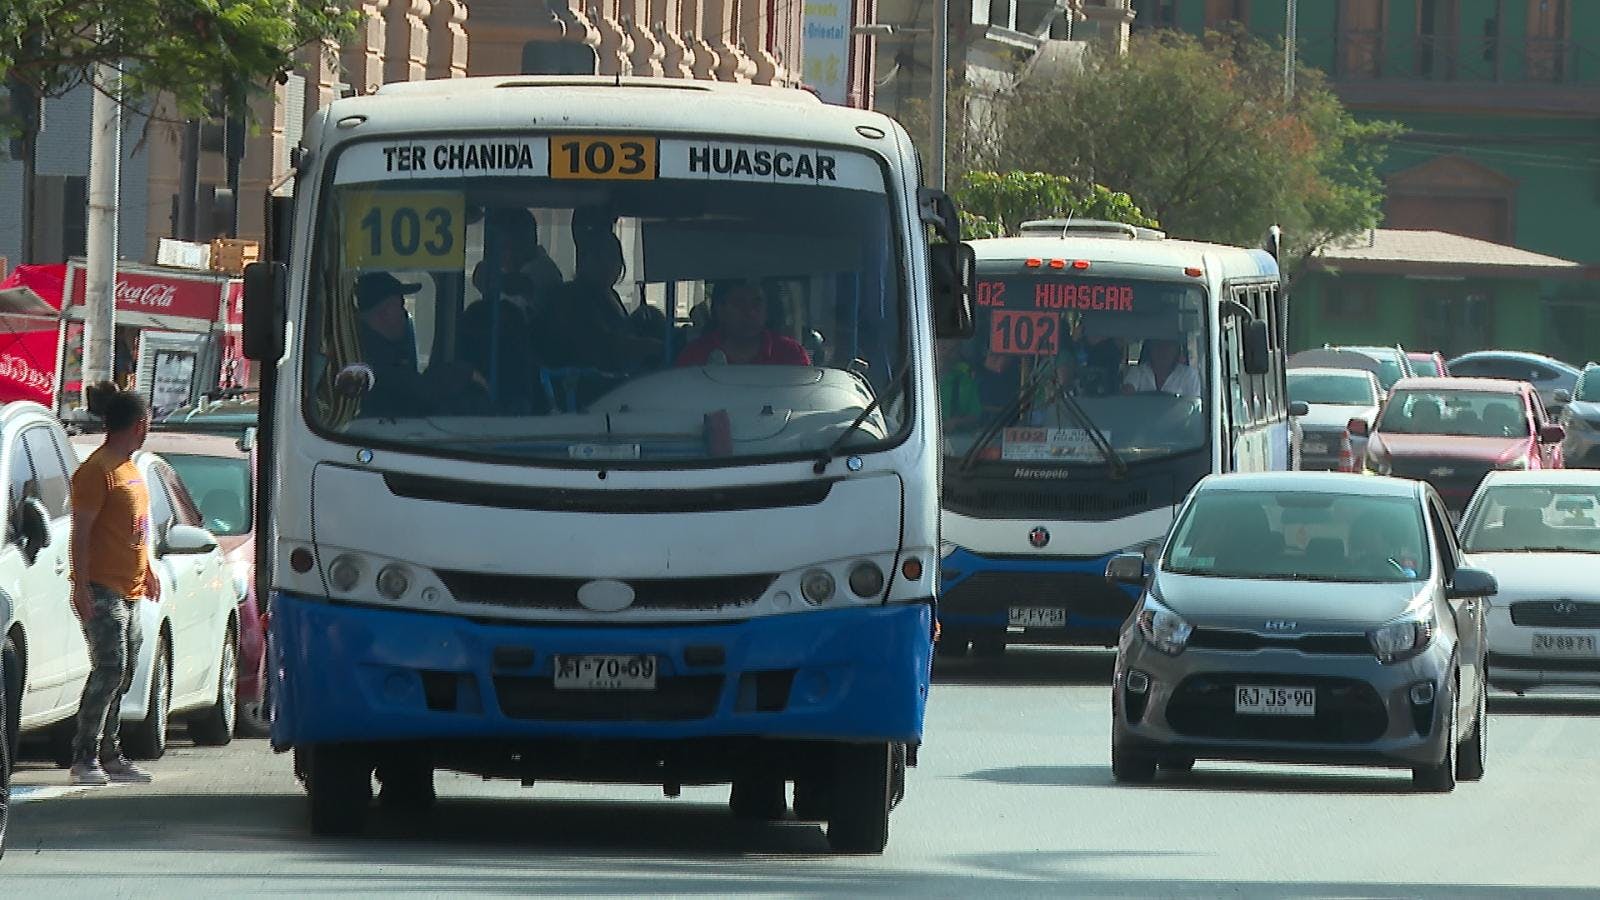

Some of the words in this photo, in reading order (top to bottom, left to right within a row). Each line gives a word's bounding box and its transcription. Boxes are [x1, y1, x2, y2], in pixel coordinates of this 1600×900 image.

[383, 147, 426, 171] TER
[433, 144, 533, 171] CHANIDA
[562, 142, 646, 174] 103
[689, 147, 836, 181] HUASCAR
[360, 206, 454, 256] 103
[977, 281, 1006, 307] 02
[1035, 283, 1134, 311] HUASCAR
[997, 315, 1056, 351] 102
